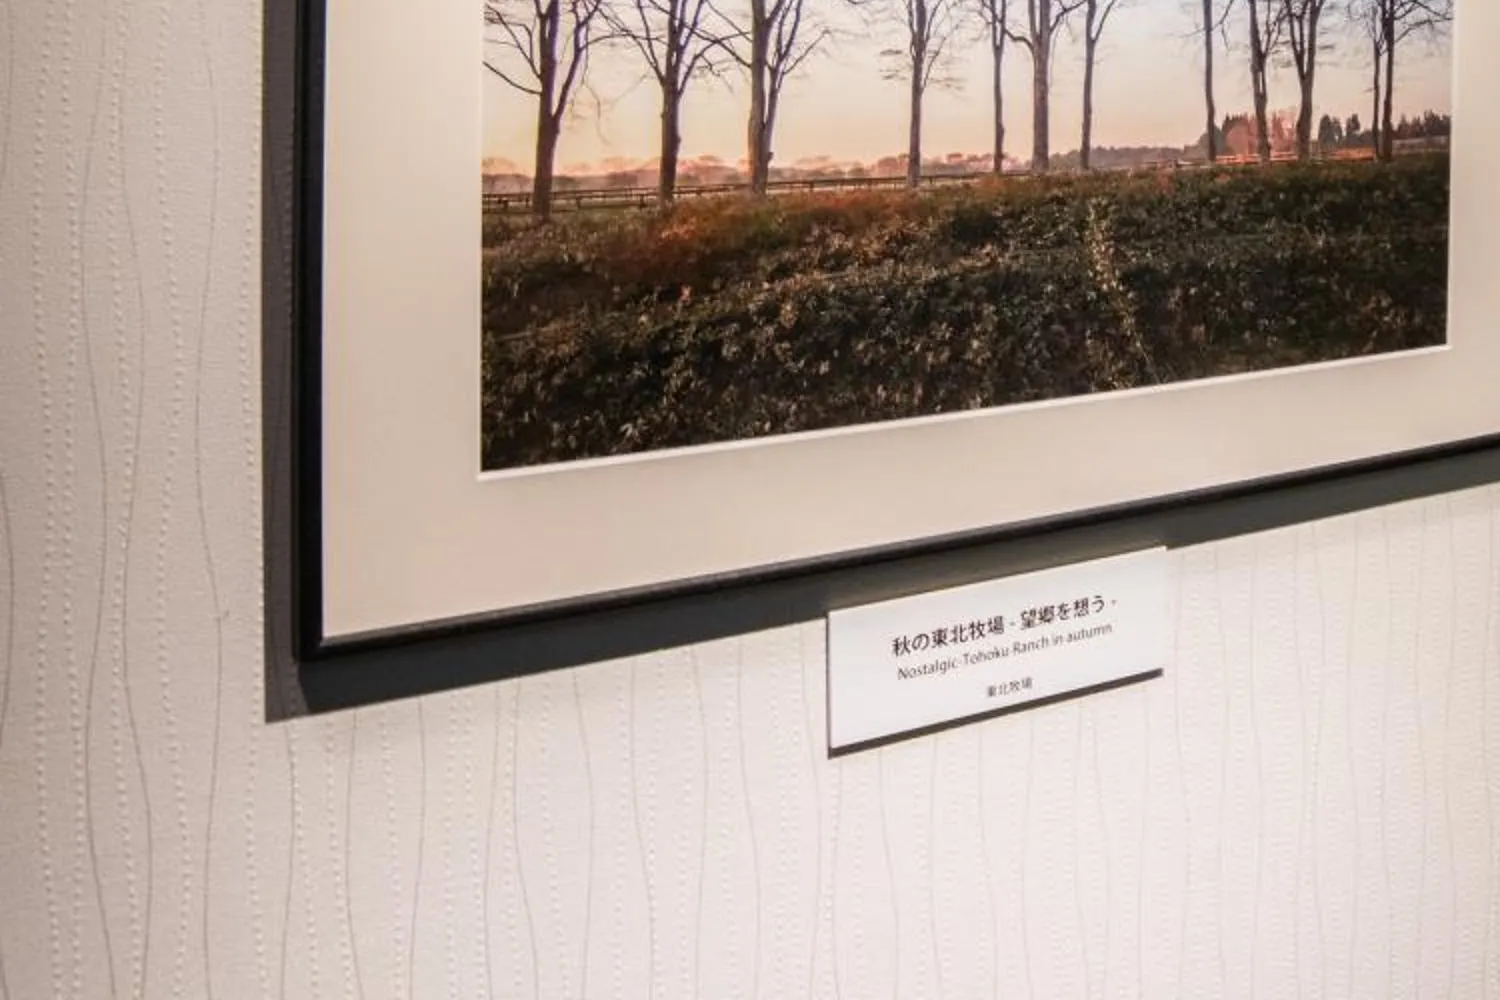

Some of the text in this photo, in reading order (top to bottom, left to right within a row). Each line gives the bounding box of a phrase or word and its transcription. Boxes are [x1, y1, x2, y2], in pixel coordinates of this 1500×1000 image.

[897, 623, 1113, 681] Nostalgic Tohoku Ranch in autumn
